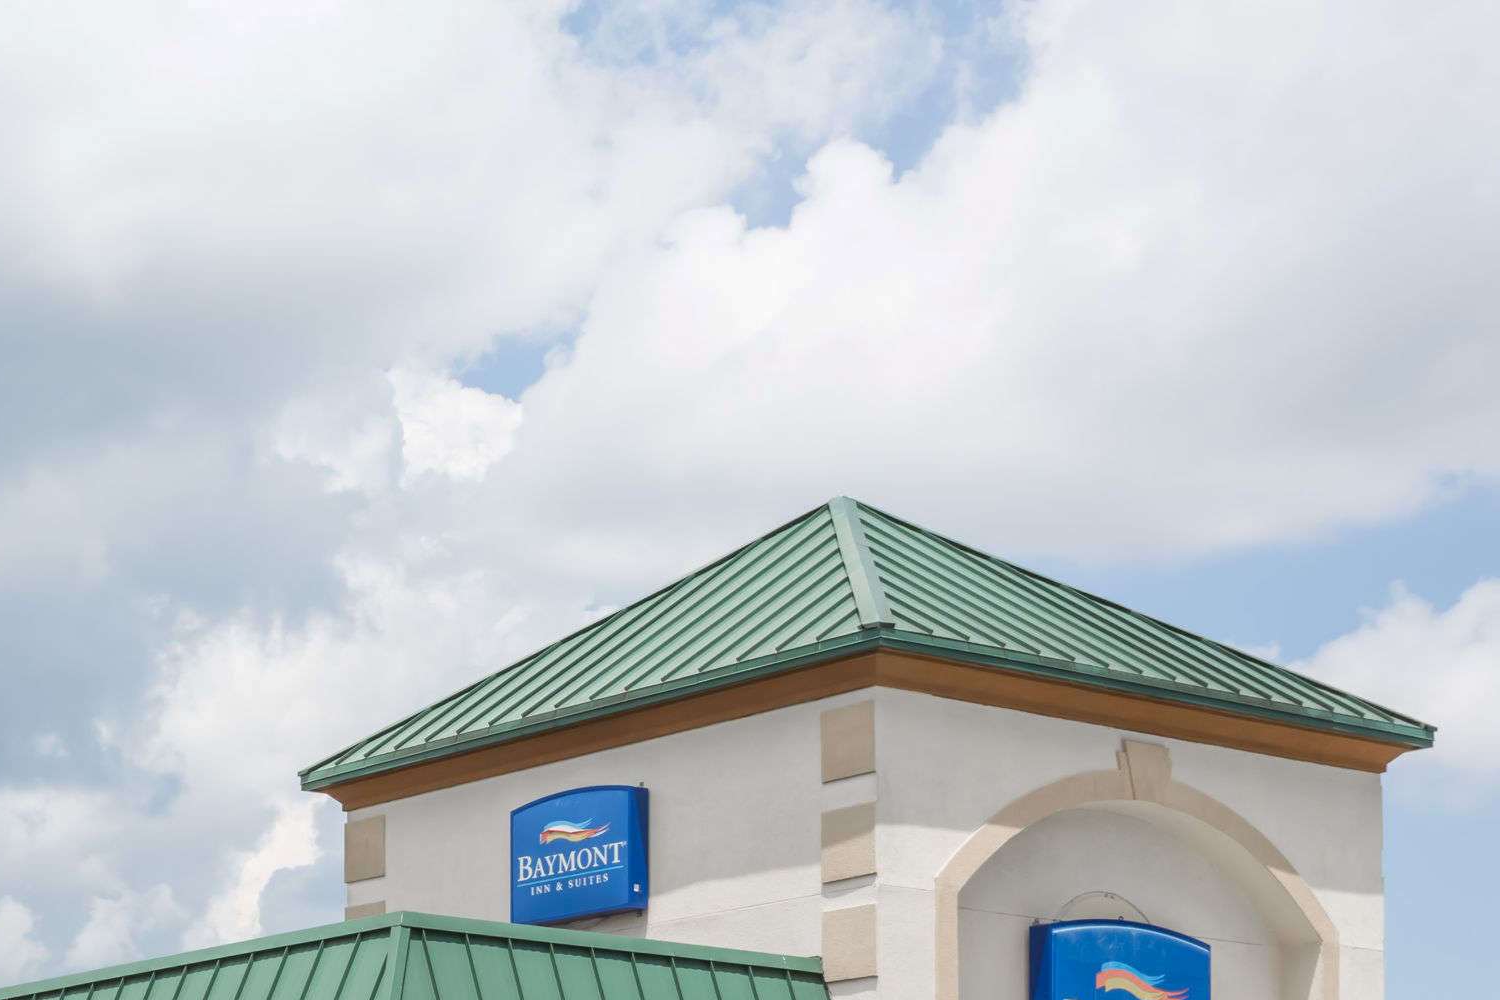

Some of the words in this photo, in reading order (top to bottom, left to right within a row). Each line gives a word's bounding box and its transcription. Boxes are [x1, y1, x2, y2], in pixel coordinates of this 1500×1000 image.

[517, 841, 624, 882] BAYMONT
[531, 884, 551, 896] INN
[555, 880, 564, 891] &
[568, 873, 609, 888] SUITES
